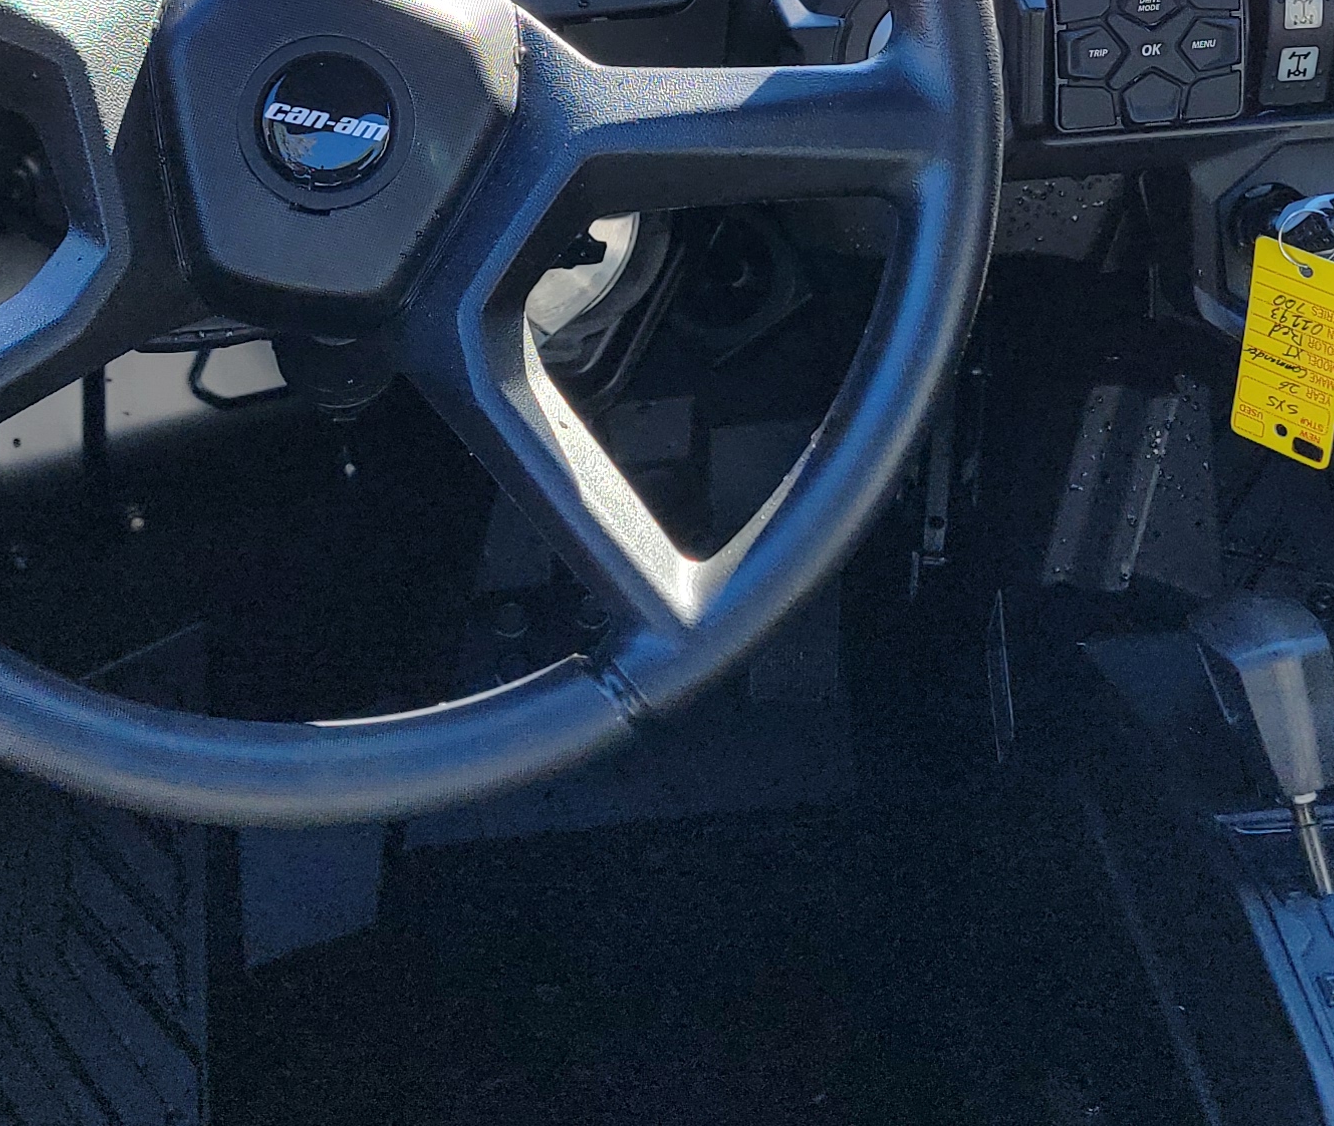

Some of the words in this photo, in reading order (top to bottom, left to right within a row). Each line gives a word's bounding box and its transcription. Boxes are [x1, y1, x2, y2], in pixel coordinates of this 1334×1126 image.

[1137, 4, 1160, 12] MODE
[1141, 44, 1162, 56] OK
[1191, 39, 1217, 49] MENU
[1088, 49, 1109, 57] TRIP
[264, 102, 390, 142] can-am
[1273, 295, 1305, 314] 700
[1268, 323, 1303, 346] Red
[1282, 345, 1304, 360] XT
[1306, 387, 1333, 406] YEAR
[1239, 403, 1263, 419] USED
[1300, 417, 1324, 432] STK#
[1299, 429, 1321, 444] NEW
